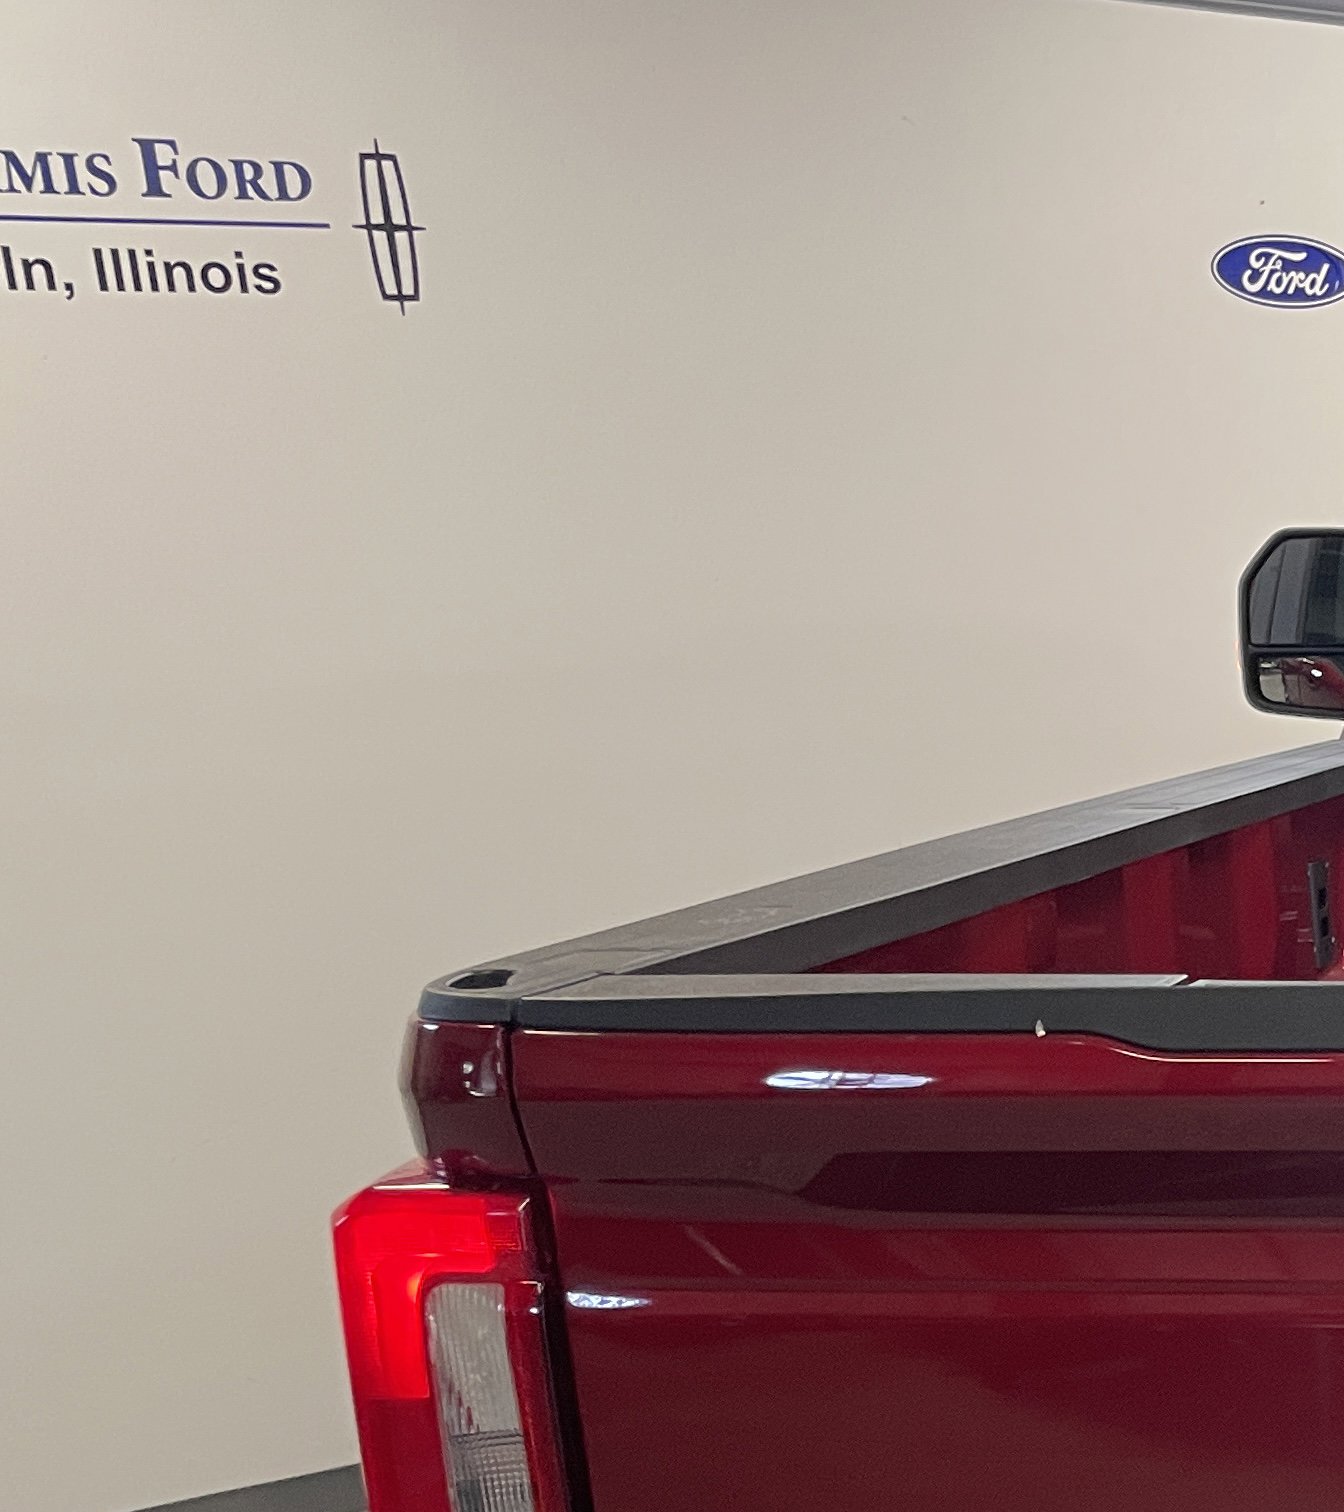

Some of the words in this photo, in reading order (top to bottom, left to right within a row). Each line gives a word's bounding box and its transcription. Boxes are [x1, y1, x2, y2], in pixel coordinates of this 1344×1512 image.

[132, 137, 312, 202] FORD
[93, 247, 282, 295] Illinois
[1241, 246, 1330, 296] Ford
